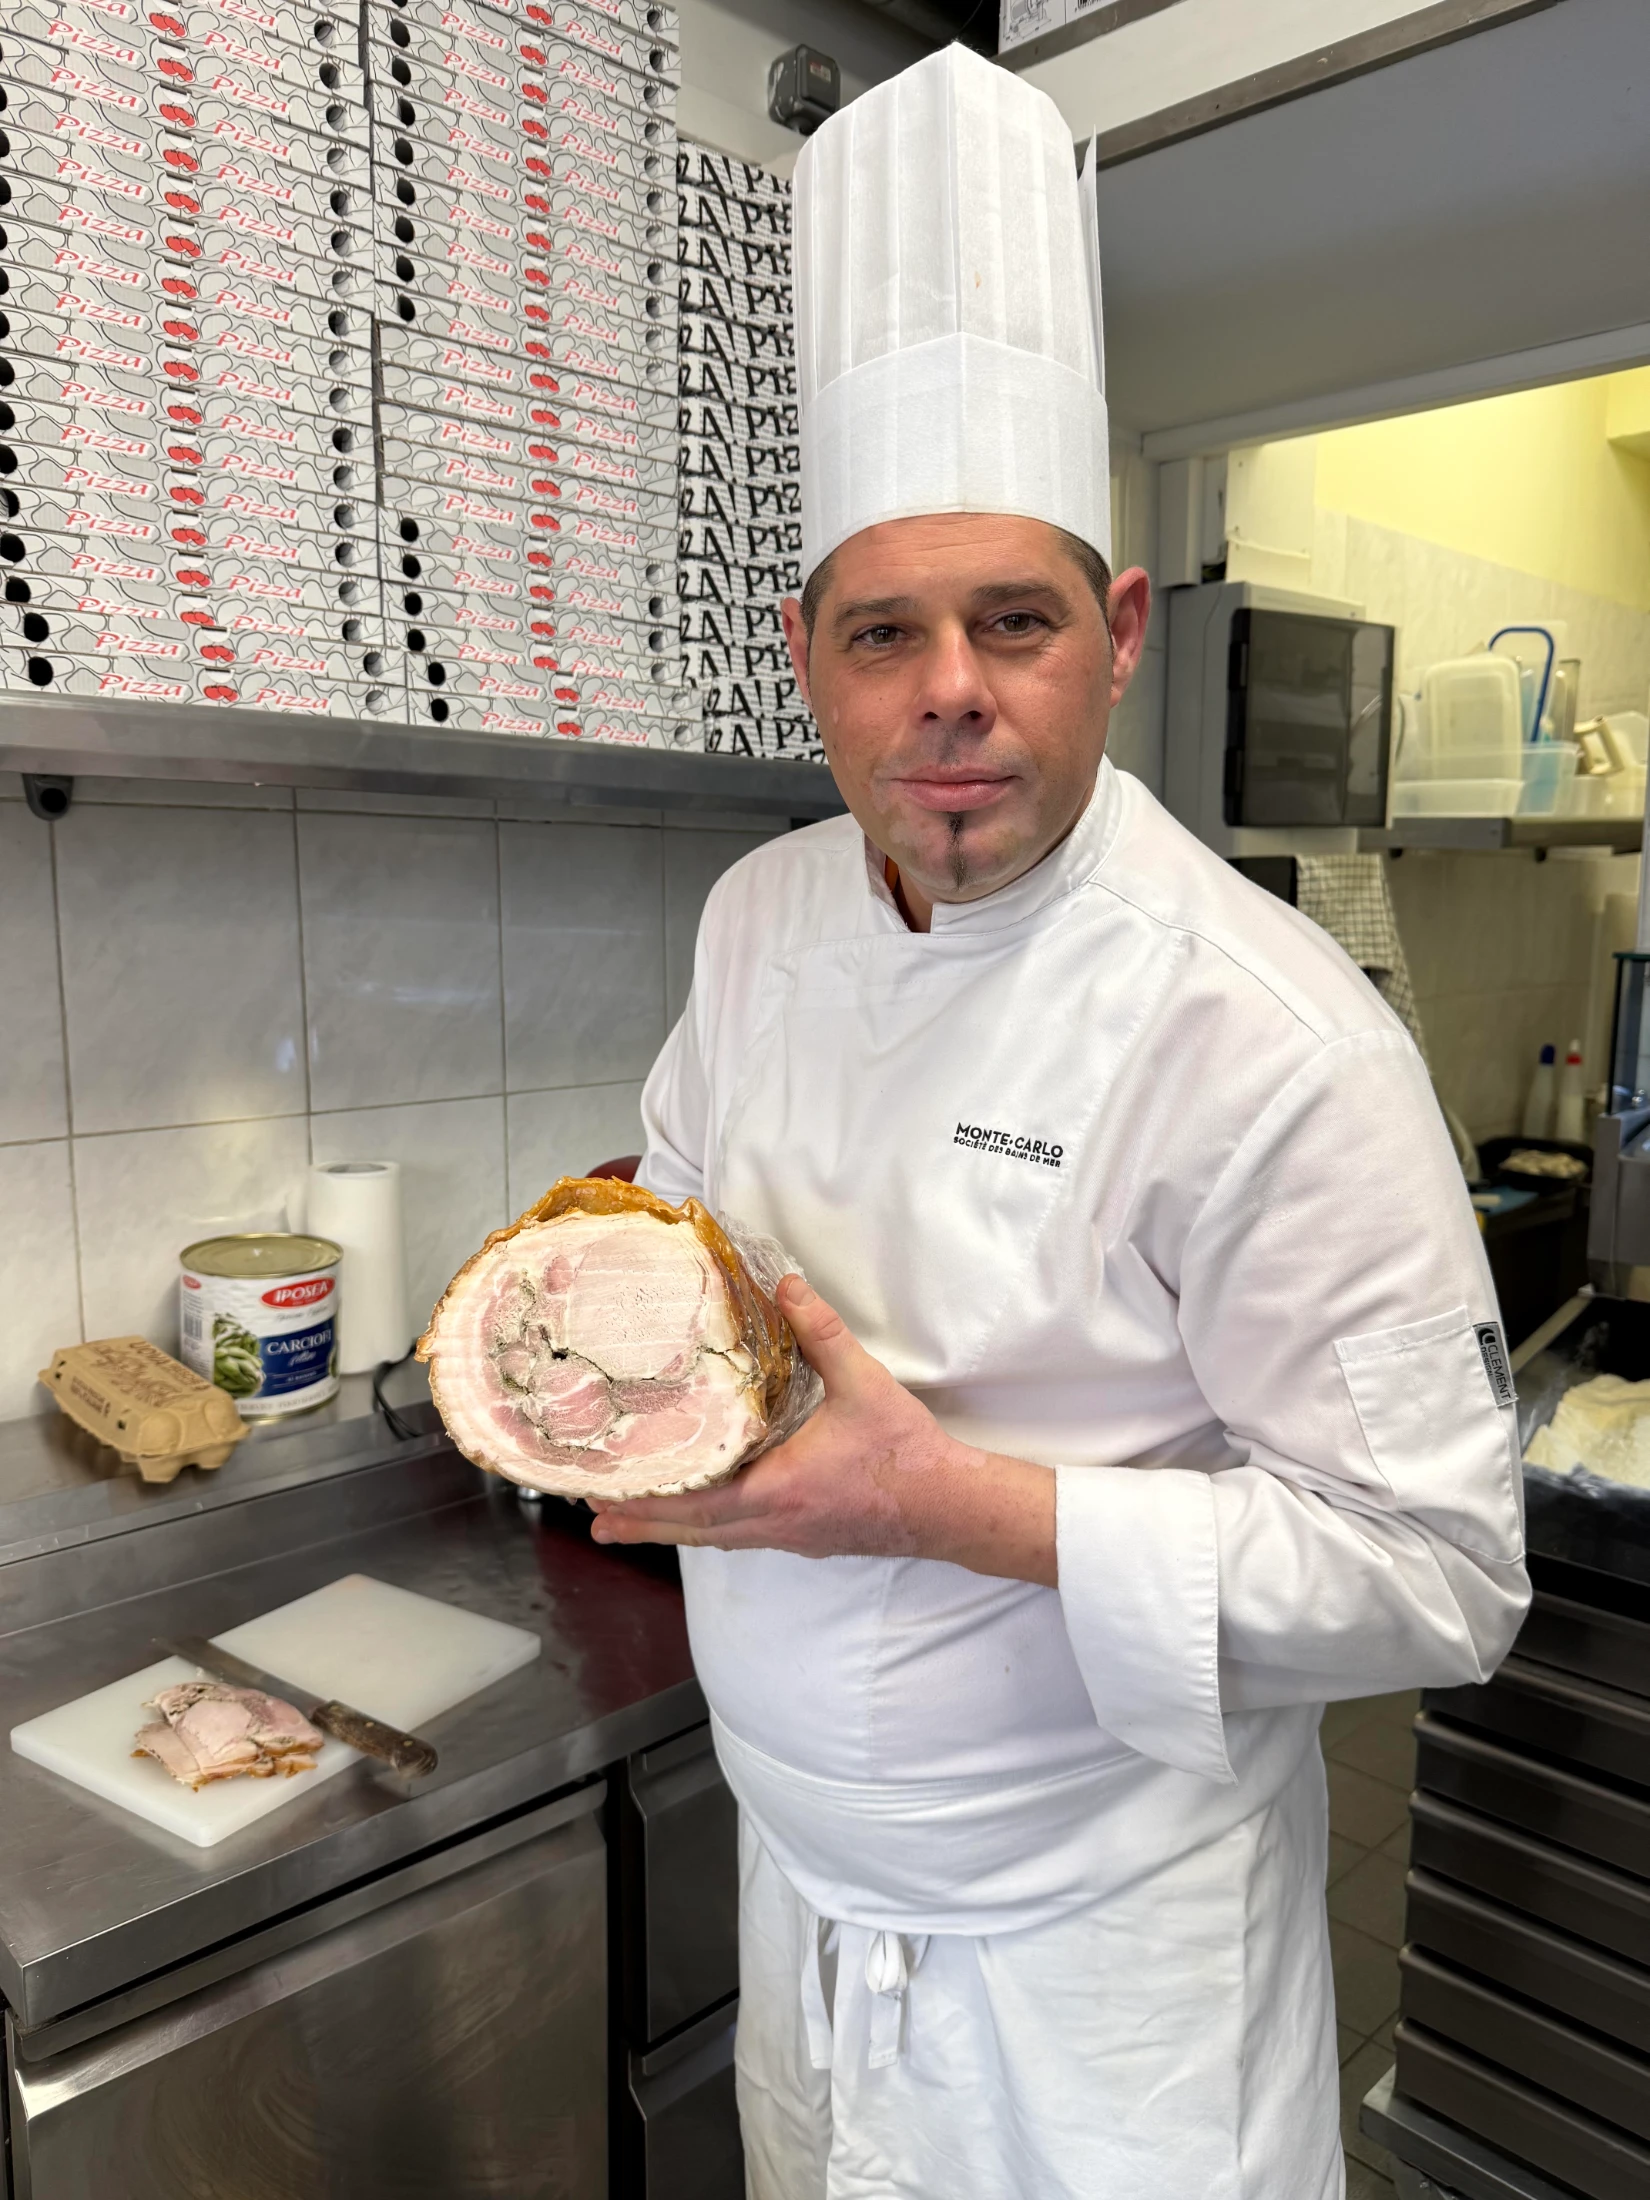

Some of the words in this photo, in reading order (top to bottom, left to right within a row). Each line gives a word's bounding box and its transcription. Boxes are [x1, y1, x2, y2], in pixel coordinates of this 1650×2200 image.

[218, 0, 276, 28] izza
[47, 19, 135, 63] Pizza
[440, 11, 505, 49] Pizza
[564, 20, 621, 55] Pizza
[203, 30, 281, 71] Pizza
[442, 50, 506, 88] Pizza
[558, 59, 616, 94] Pizza
[49, 65, 138, 108] Pizza
[210, 74, 288, 113] Pizza
[443, 87, 507, 124] Pizza
[560, 97, 617, 131] Pizza
[53, 112, 142, 155] Pizza
[212, 119, 289, 158] Pizza
[447, 127, 511, 163] Pizza
[559, 132, 617, 165] Pizza
[56, 157, 143, 197] Pizza
[215, 163, 293, 201] Pizza
[446, 165, 510, 200] Pizza
[563, 169, 619, 201] Pizza
[57, 203, 145, 243] Pizza
[217, 204, 294, 241] Pizza
[448, 205, 511, 239] Pizza
[562, 205, 619, 237] Pizza
[53, 247, 140, 285] Pizza
[217, 247, 295, 283] Pizza
[446, 241, 510, 274] Pizza
[563, 242, 620, 273] Pizza
[214, 289, 291, 323] Pizza
[446, 279, 510, 311] Pizza
[562, 277, 619, 307] Pizza
[55, 291, 142, 328] Pizza
[447, 319, 510, 349] Pizza
[562, 313, 618, 342] Pizza
[55, 334, 142, 369] Pizza
[215, 330, 292, 364] Pizza
[442, 348, 513, 382] Pizza
[563, 349, 619, 377] Pizza
[59, 380, 146, 414] Pizza
[216, 370, 292, 401] Pizza
[573, 381, 637, 412] Pizza
[444, 385, 514, 417] Pizza
[60, 423, 147, 455] Pizza
[219, 413, 295, 443] Pizza
[441, 421, 512, 453] Pizza
[574, 416, 637, 446] Pizza
[219, 453, 296, 481] Pizza
[445, 458, 515, 488] Pizza
[573, 450, 636, 479] Pizza
[63, 466, 149, 496] Pizza
[221, 493, 297, 521] Pizza
[444, 493, 515, 523] Pizza
[575, 485, 637, 513] Pizza
[64, 508, 151, 537] Pizza
[575, 519, 637, 546] Pizza
[223, 533, 298, 560] Pizza
[450, 535, 513, 561] Pizza
[70, 552, 155, 581] Pizza
[564, 556, 619, 579] Pizza
[227, 574, 302, 600] Pizza
[452, 570, 515, 595] Pizza
[76, 595, 160, 621] Pizza
[567, 589, 622, 612] Pizza
[232, 614, 305, 638] Pizza
[454, 607, 516, 631] Pizza
[94, 631, 179, 657] Pizza
[567, 625, 622, 647] Pizza
[252, 648, 326, 672] Pizza
[456, 643, 518, 665] Pizza
[569, 658, 624, 680] Pizza
[97, 672, 183, 697] Pizza
[254, 687, 329, 710] Pizza
[478, 675, 539, 697] Pizza
[591, 689, 646, 710] Pizza
[480, 711, 543, 733] Pizza
[593, 723, 648, 743] Pizza
[988, 1144, 1003, 1154] DES
[1004, 1147, 1028, 1160] BAINS
[1029, 1153, 1041, 1163] DE
[1043, 1157, 1061, 1168] MER
[275, 1281, 328, 1303] IPOSEA
[266, 1329, 332, 1355] CARCIOFI
[1480, 1346, 1493, 1377] DESIGN
[1488, 1344, 1511, 1400] CLEMENT
